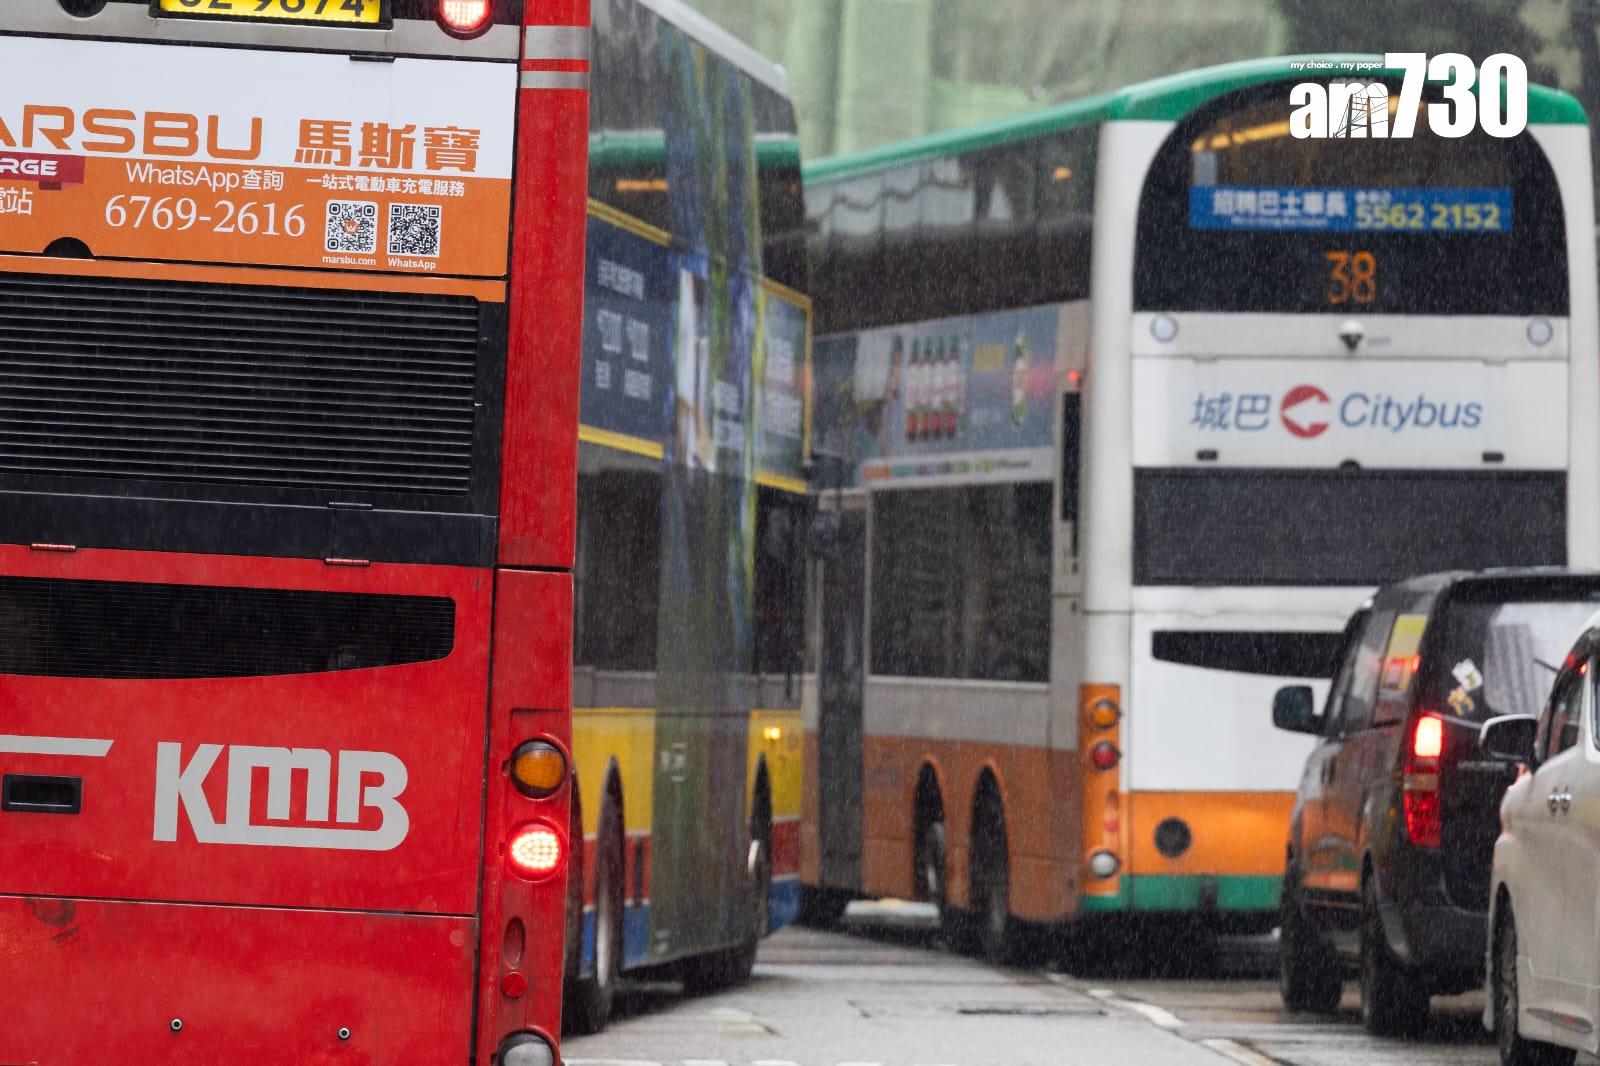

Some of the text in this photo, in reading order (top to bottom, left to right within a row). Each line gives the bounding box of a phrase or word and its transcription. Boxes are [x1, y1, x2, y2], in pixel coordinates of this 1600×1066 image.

[0, 104, 481, 172] RSBU 馬斯寶
[306, 173, 466, 198] 一站式電動車充電服務
[104, 194, 306, 238] 6769-2616
[1355, 203, 1425, 229] 5562
[1431, 203, 1500, 229] 2152
[321, 255, 377, 267] marsbu.com
[387, 257, 437, 271] WhatsApp
[1326, 250, 1376, 304] 38
[1190, 392, 1272, 432] 城巴
[1338, 391, 1484, 433] Citybus
[152, 741, 410, 851] KMB
